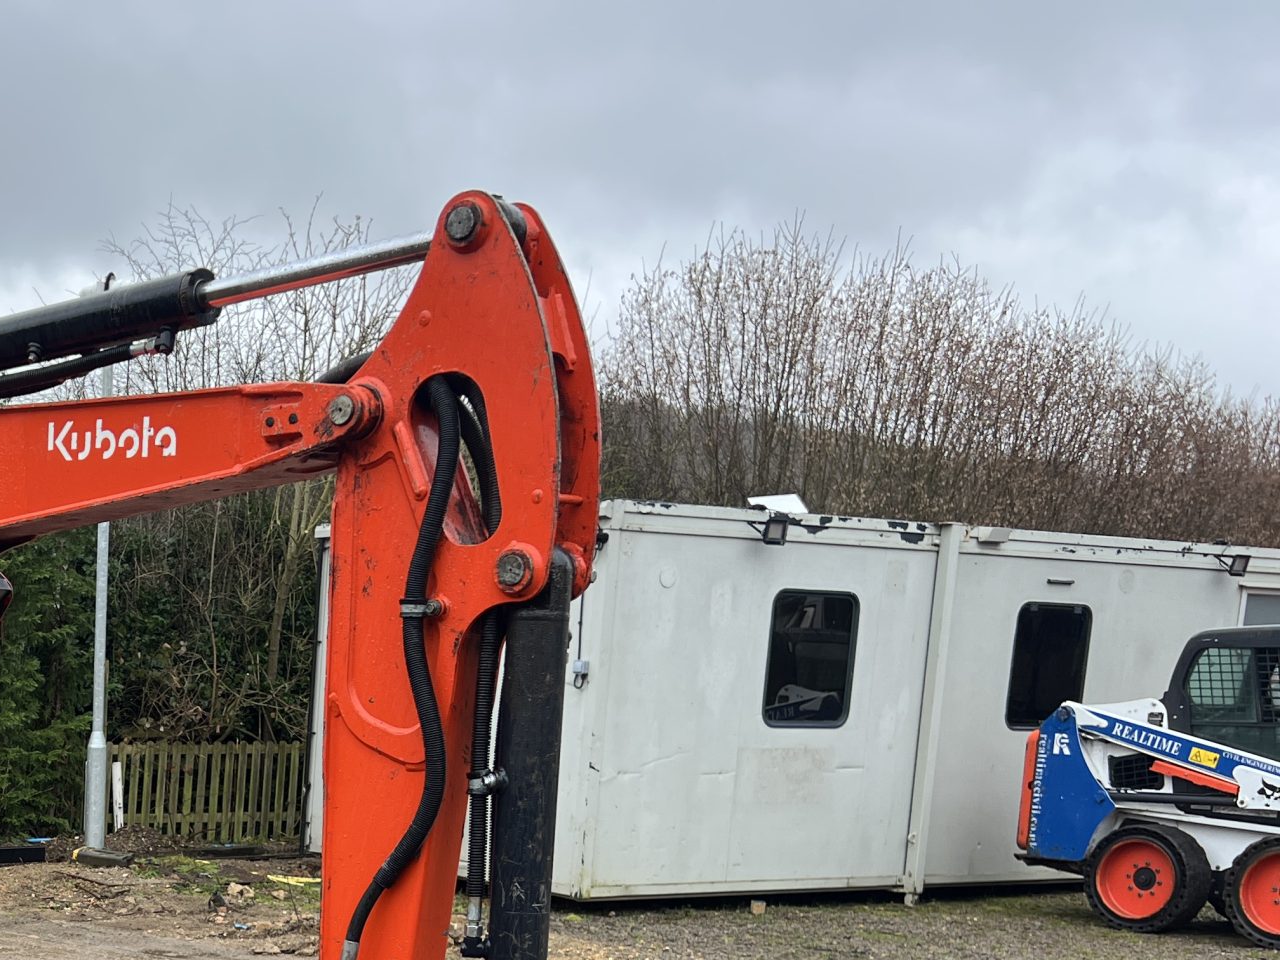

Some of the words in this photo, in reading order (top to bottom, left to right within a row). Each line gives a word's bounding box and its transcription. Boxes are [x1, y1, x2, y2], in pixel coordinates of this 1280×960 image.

[47, 415, 177, 461] Kubota
[1112, 722, 1182, 755] REALTIME
[1222, 751, 1240, 762] CIVIL
